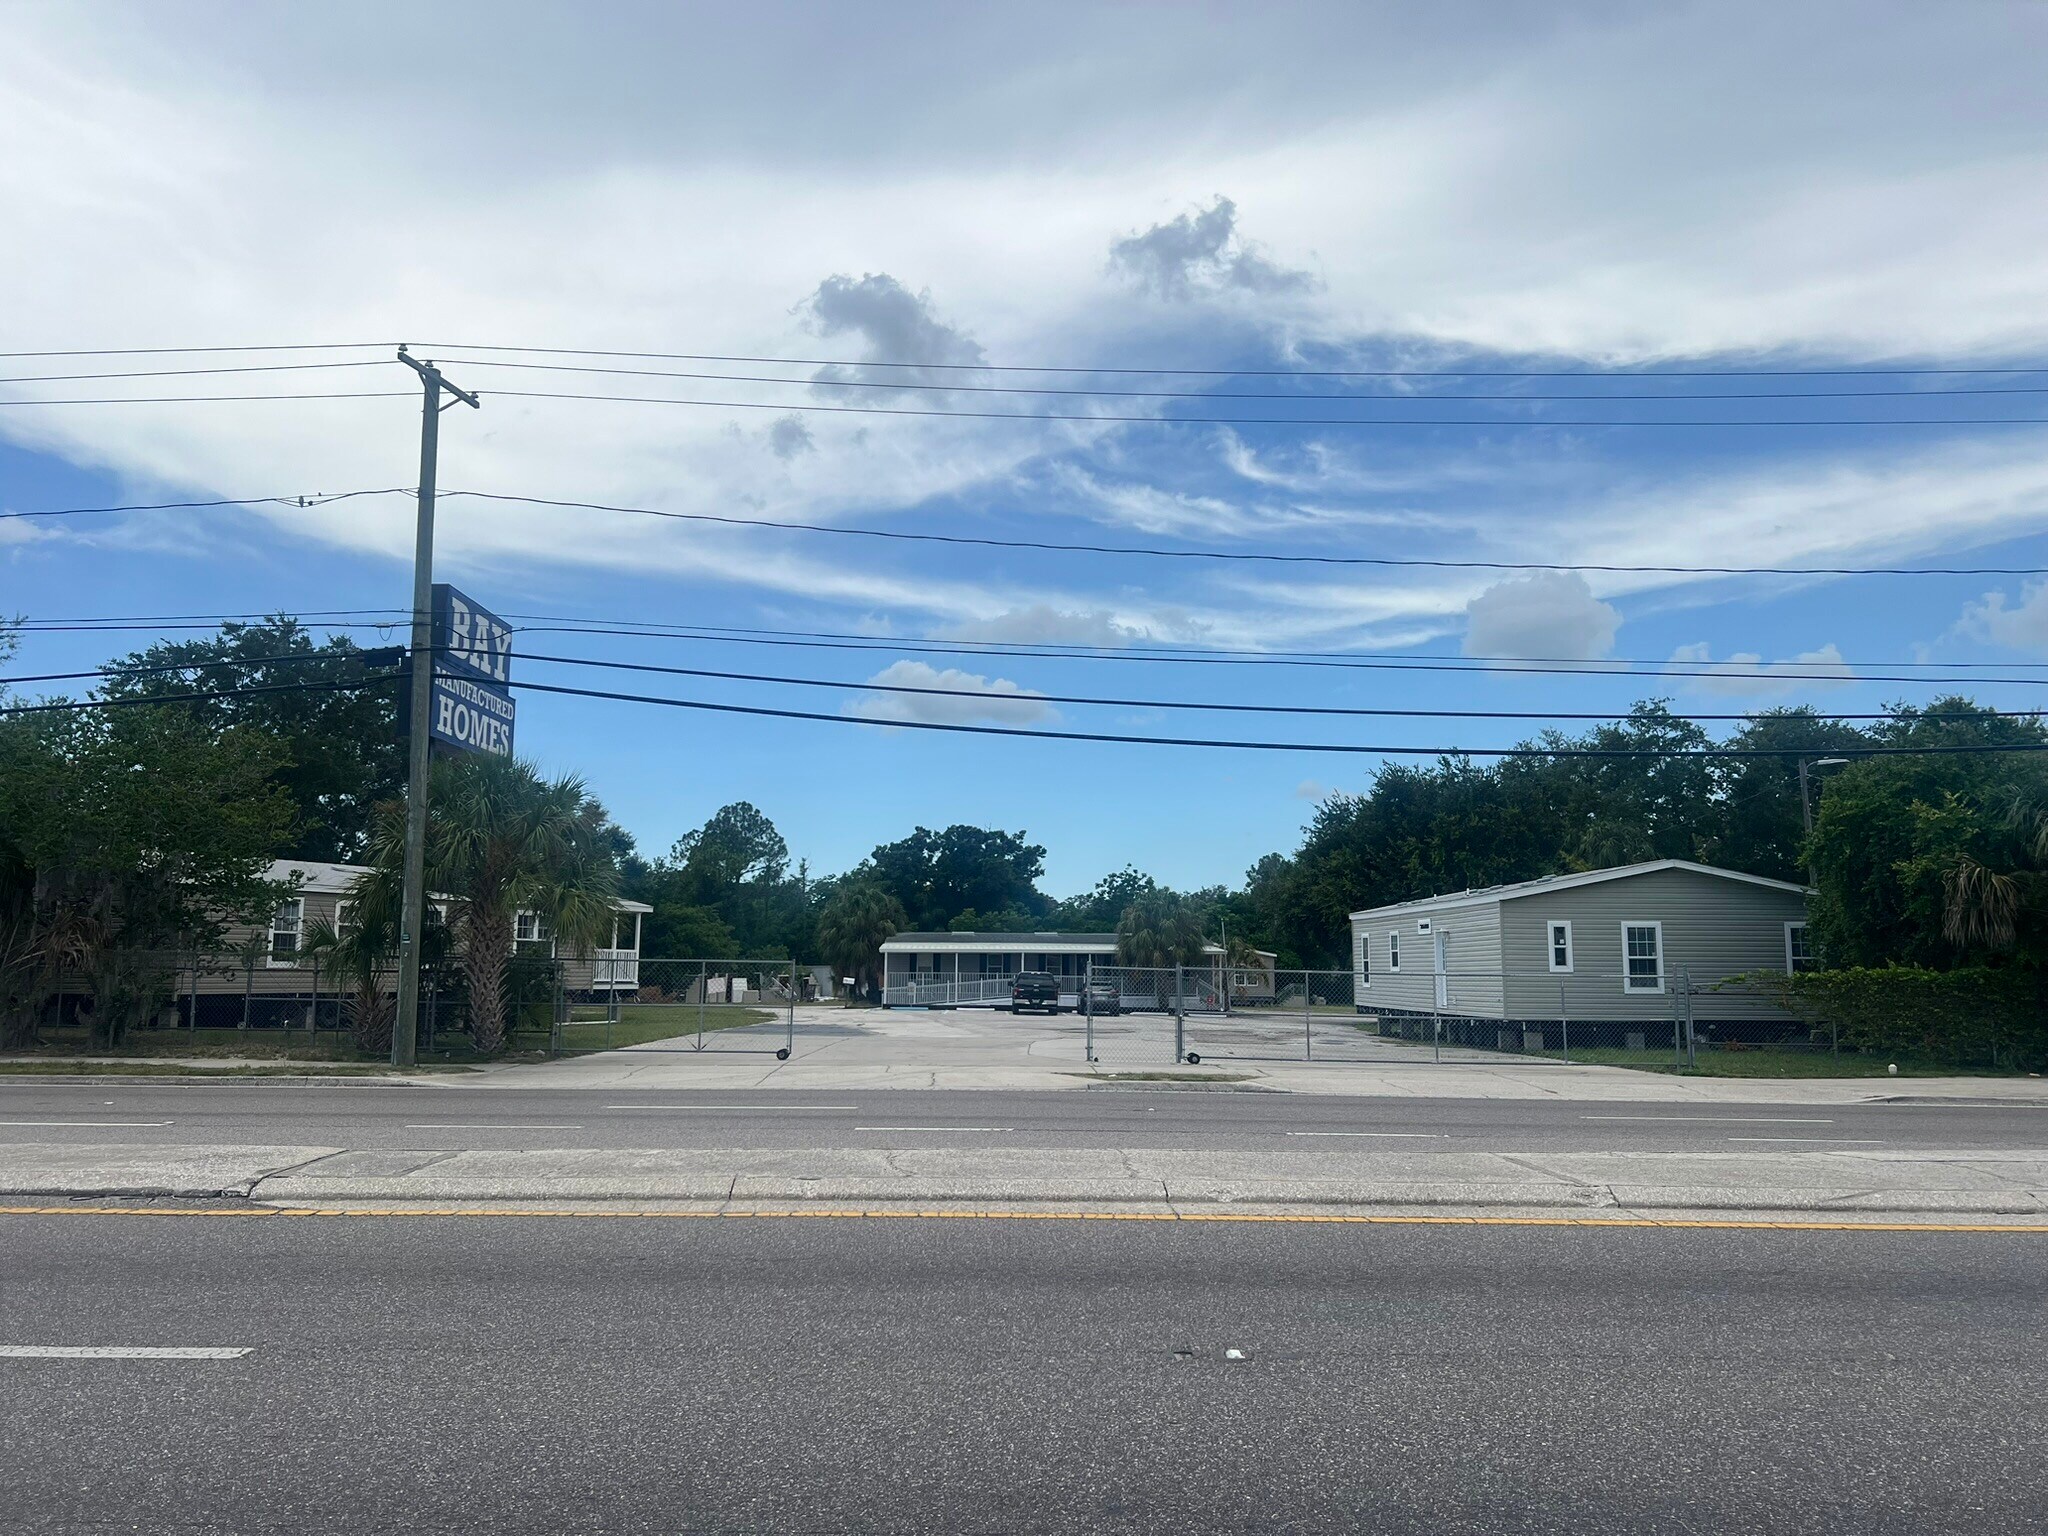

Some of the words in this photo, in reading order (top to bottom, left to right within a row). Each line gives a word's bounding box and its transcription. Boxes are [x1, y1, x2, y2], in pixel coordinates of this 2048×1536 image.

[448, 597, 511, 681] BAY
[435, 665, 514, 720] MANUFACTURED
[436, 694, 509, 757] HOMES
